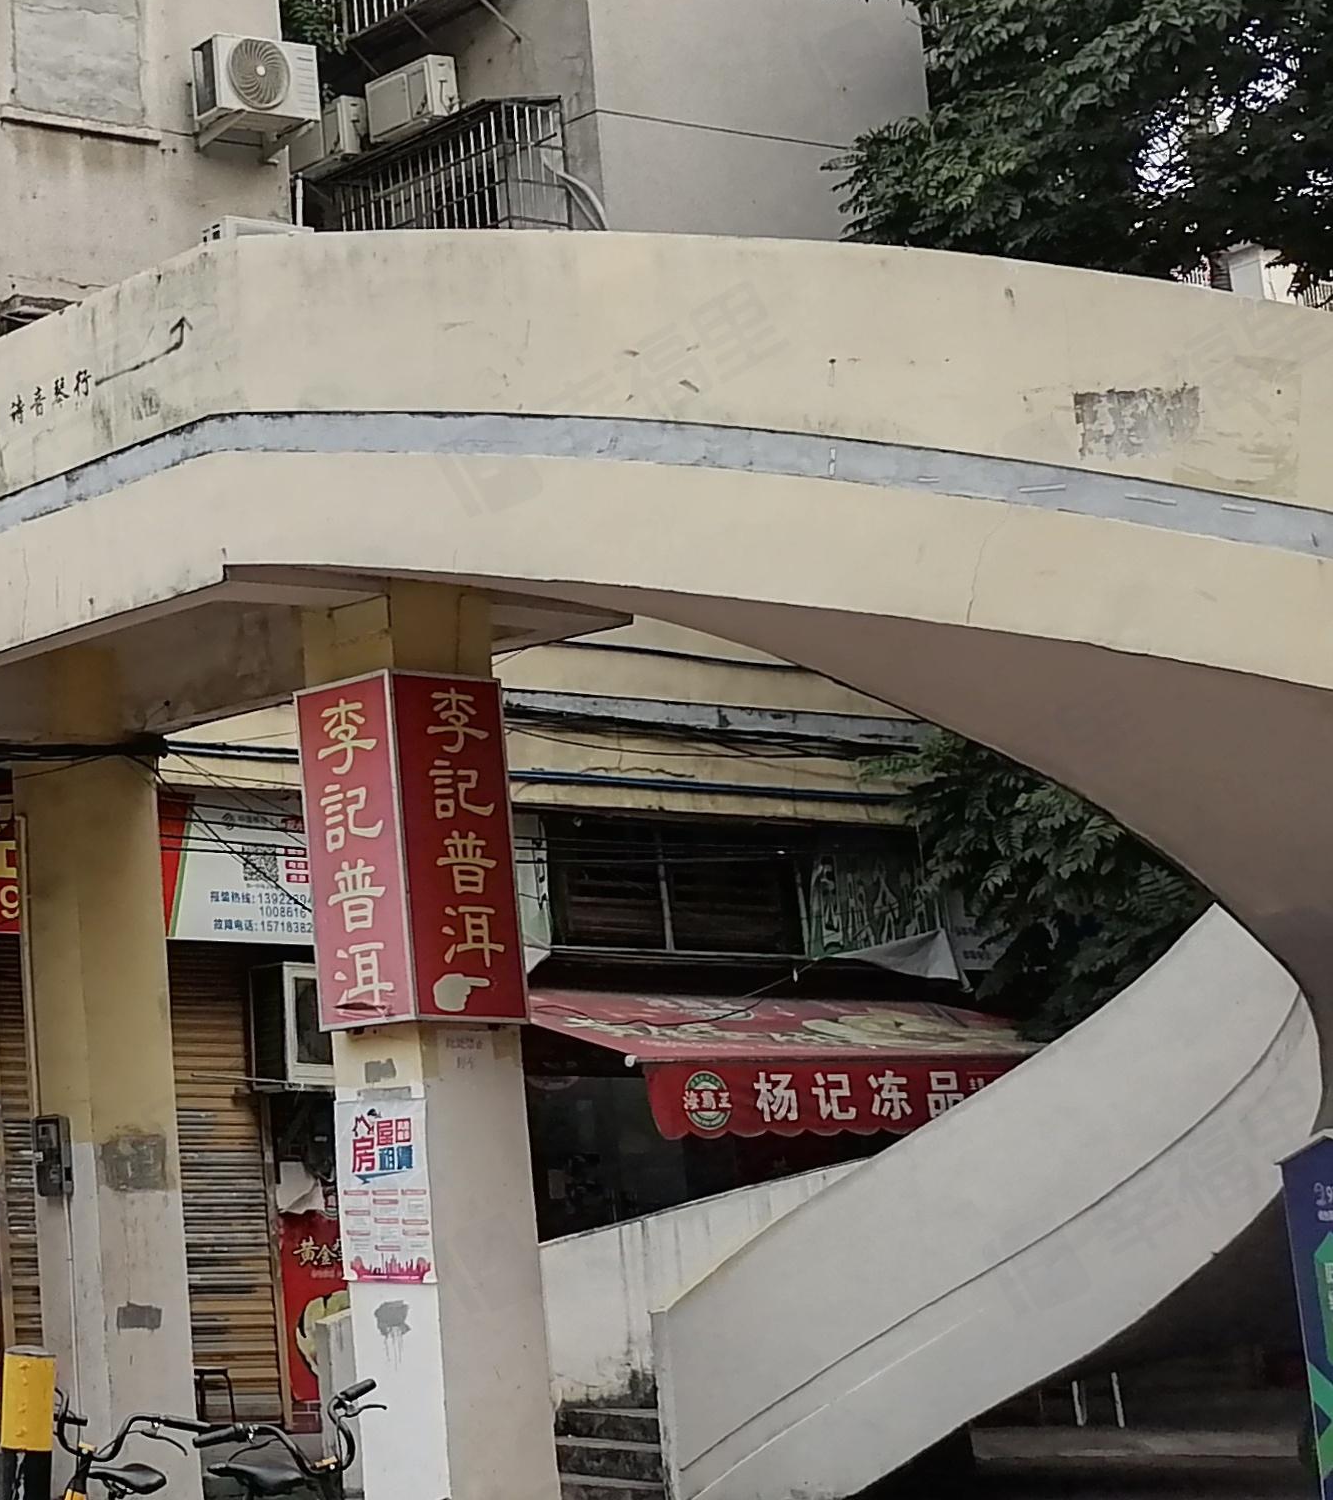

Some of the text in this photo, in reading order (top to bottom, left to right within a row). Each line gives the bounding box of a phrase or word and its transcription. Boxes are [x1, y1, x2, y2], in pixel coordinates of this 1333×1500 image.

[318, 698, 395, 1008] 李記普洱
[426, 687, 505, 968] 李記普洱
[753, 1070, 965, 1123] 杨记冻品
